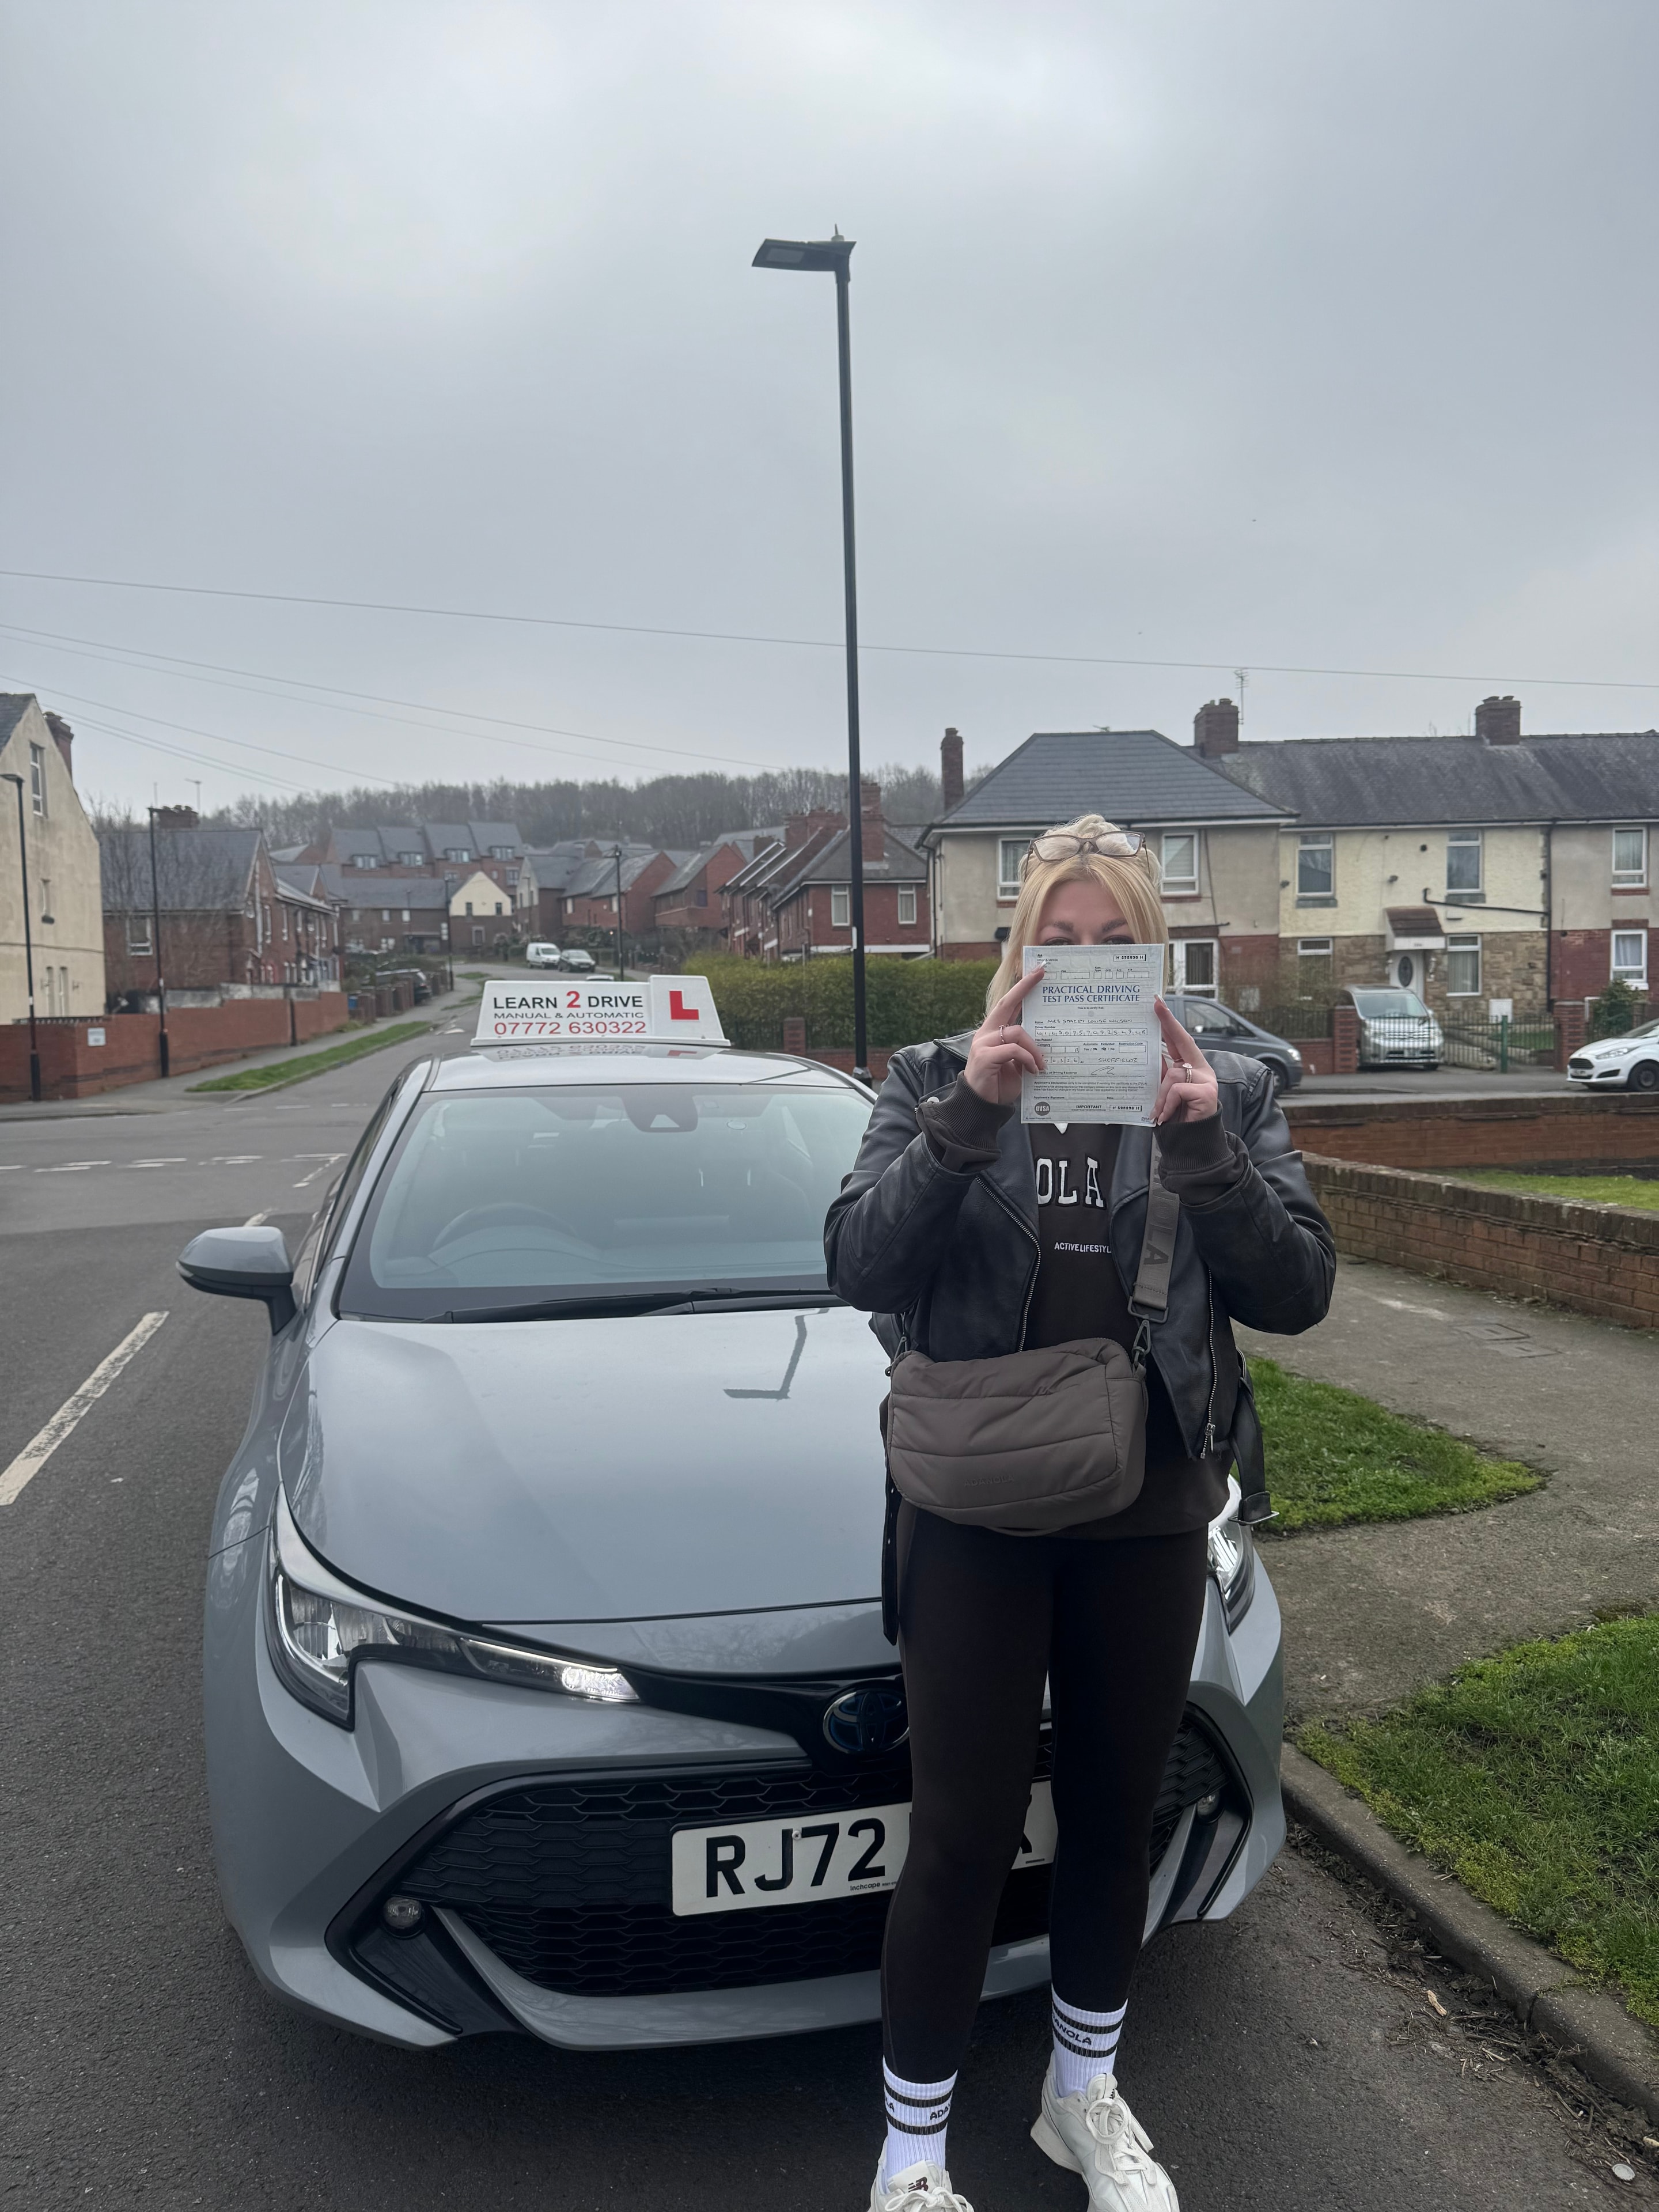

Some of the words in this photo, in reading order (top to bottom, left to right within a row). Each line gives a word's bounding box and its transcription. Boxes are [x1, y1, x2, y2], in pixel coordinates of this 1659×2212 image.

[1043, 986, 1094, 994] PRACTICAL
[1097, 985, 1140, 993] DRIVING
[494, 997, 558, 1009] LEARN
[566, 991, 581, 1008] 2
[588, 996, 643, 1007] DRIVE
[669, 990, 699, 1020] L
[494, 1022, 562, 1035] 07772
[569, 1021, 647, 1035] 630322
[850, 1883, 881, 1892] Inchcape
